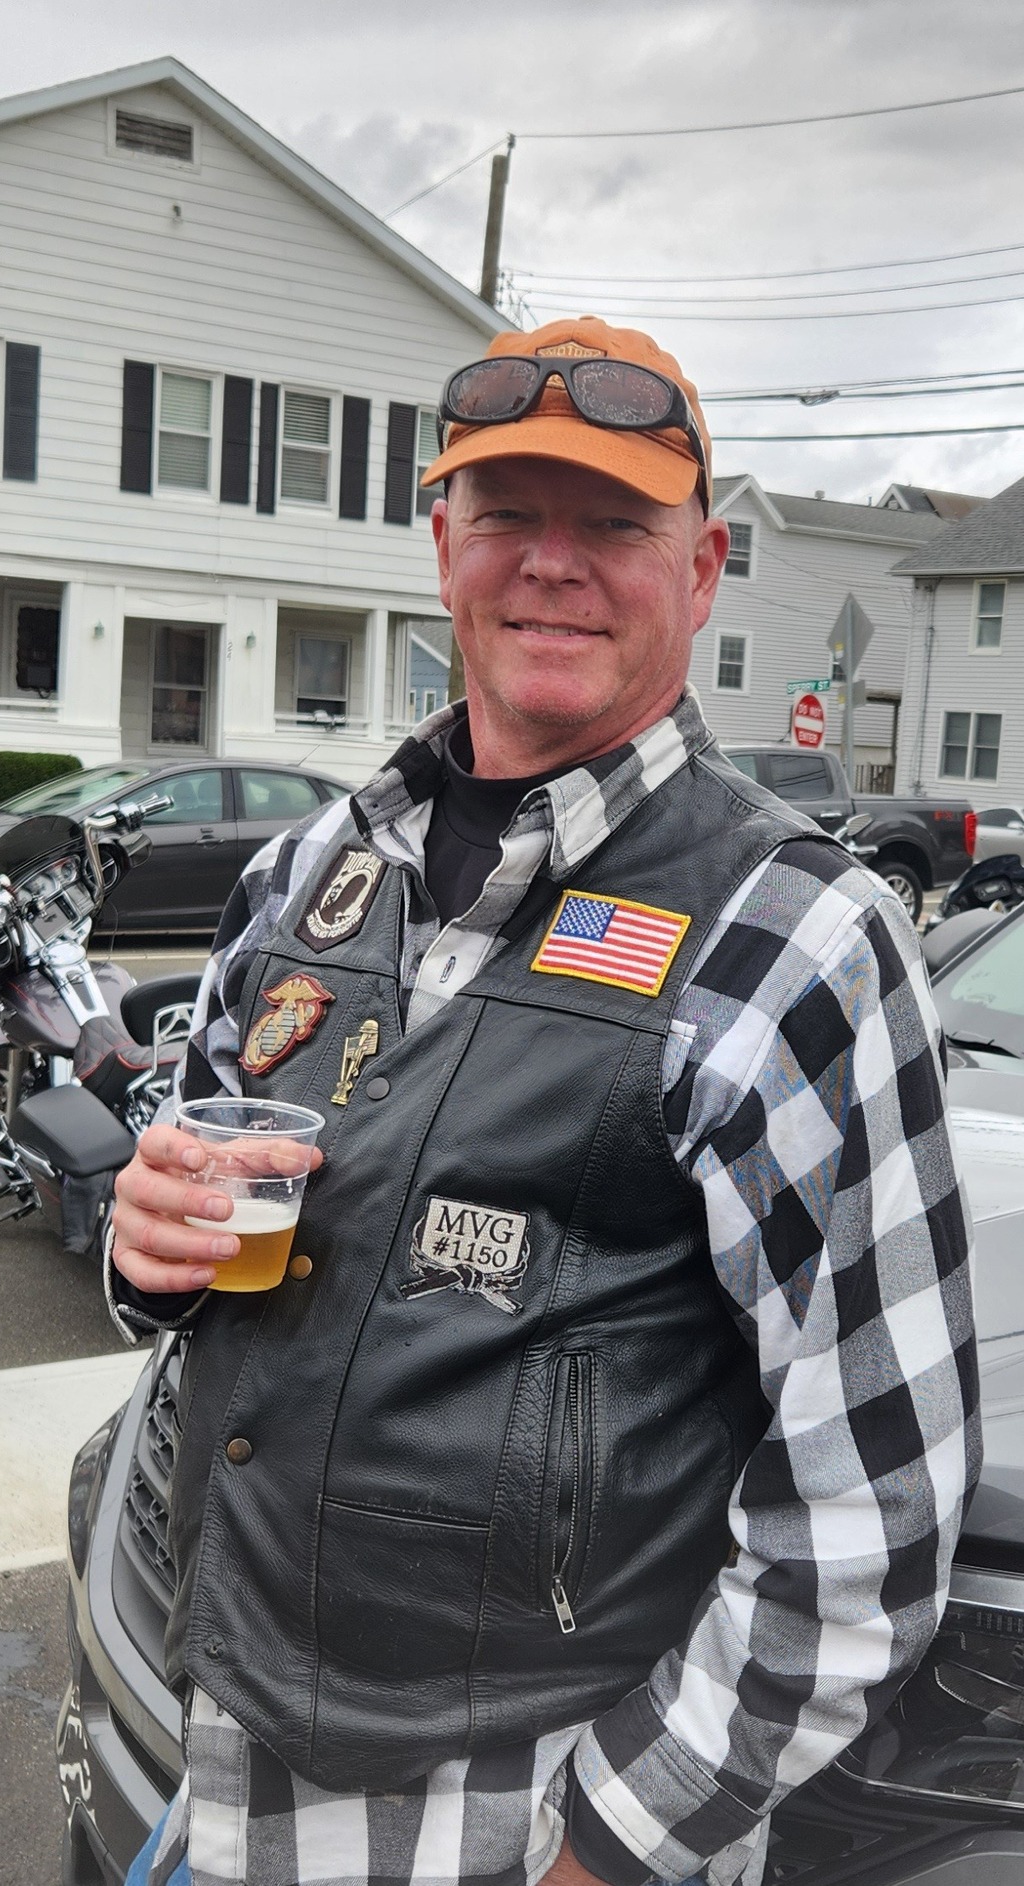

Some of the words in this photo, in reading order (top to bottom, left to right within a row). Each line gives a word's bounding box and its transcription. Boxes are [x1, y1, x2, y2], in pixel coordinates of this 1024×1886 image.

[798, 703, 808, 715] DO
[809, 706, 823, 718] NOT
[798, 730, 818, 744] ENTER
[435, 1205, 515, 1244] MVG
[432, 1236, 508, 1268] #1150
